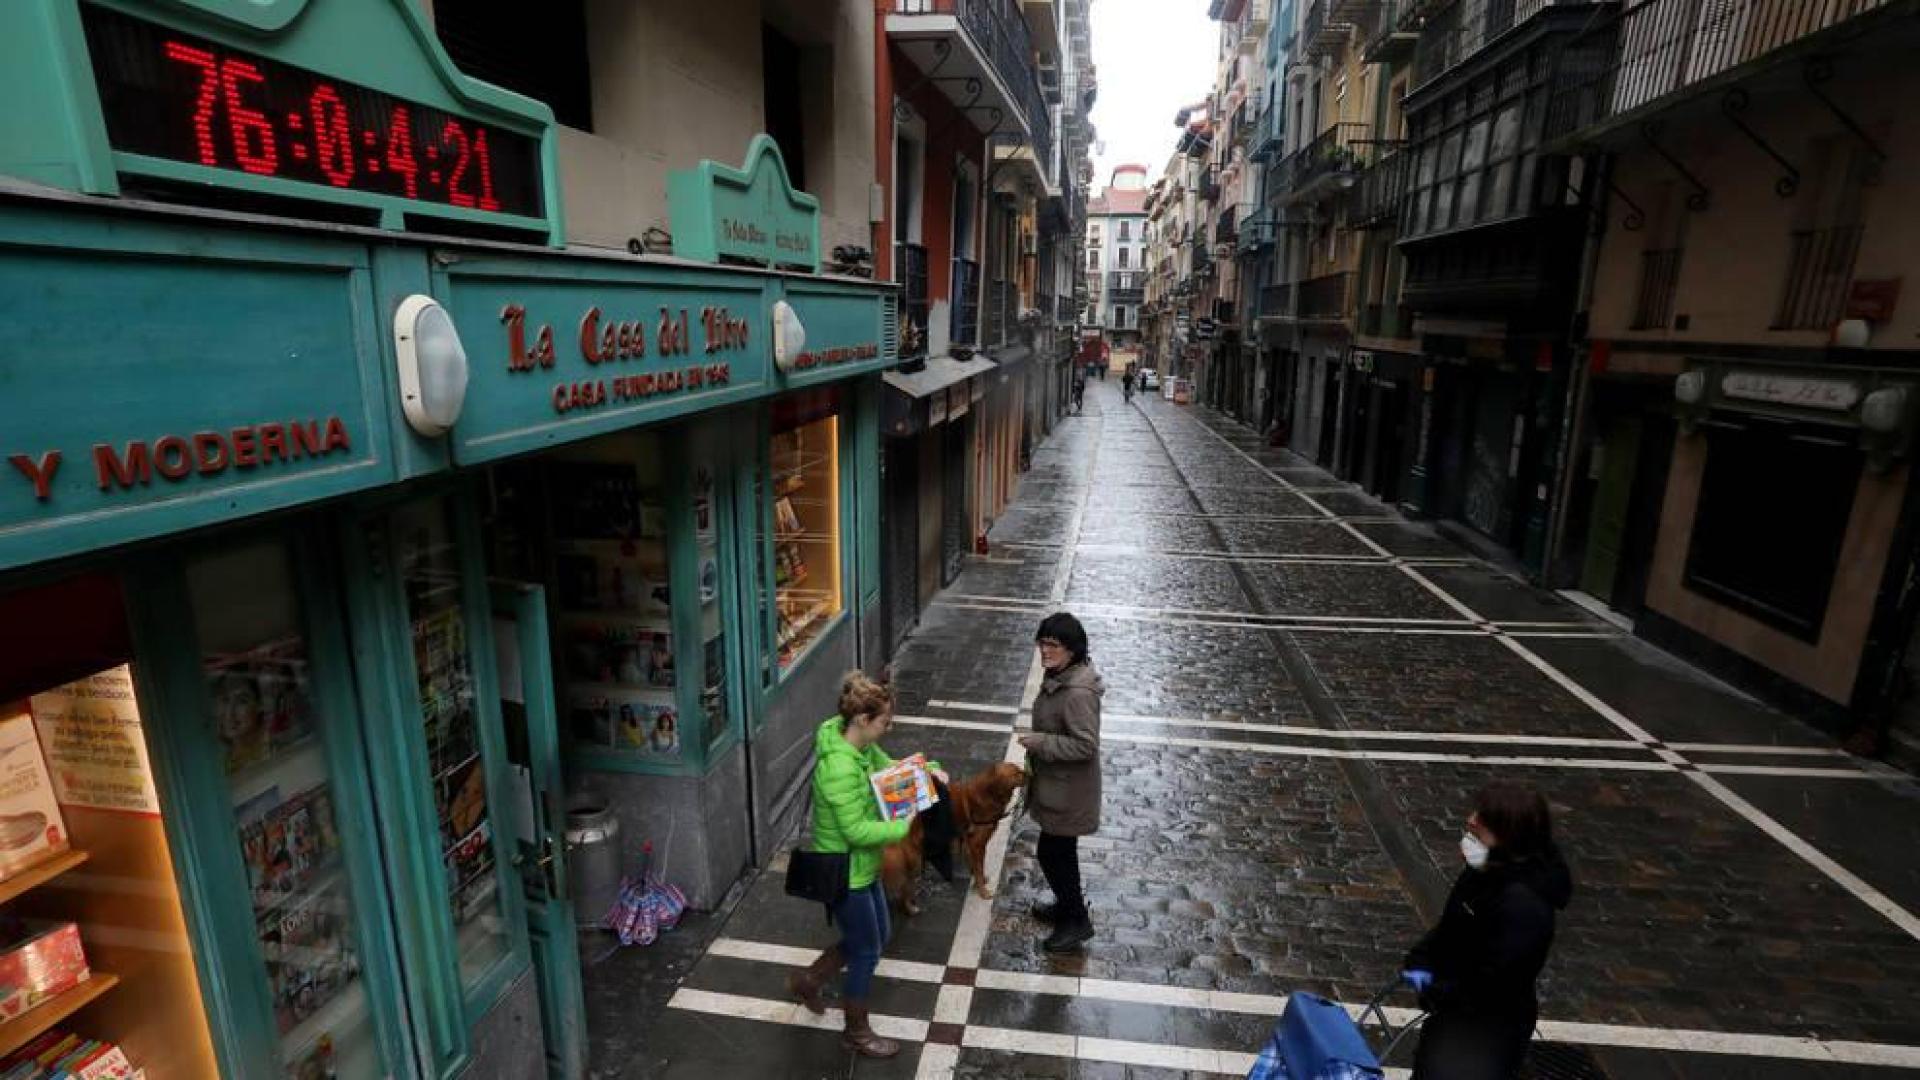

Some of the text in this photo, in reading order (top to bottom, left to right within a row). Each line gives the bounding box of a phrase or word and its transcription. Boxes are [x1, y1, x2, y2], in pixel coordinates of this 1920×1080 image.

[501, 304, 748, 372] La Casa del Libro
[554, 383, 607, 413] CASA
[613, 371, 683, 403] FUNDADA
[8, 417, 349, 501] Y MODERNA
